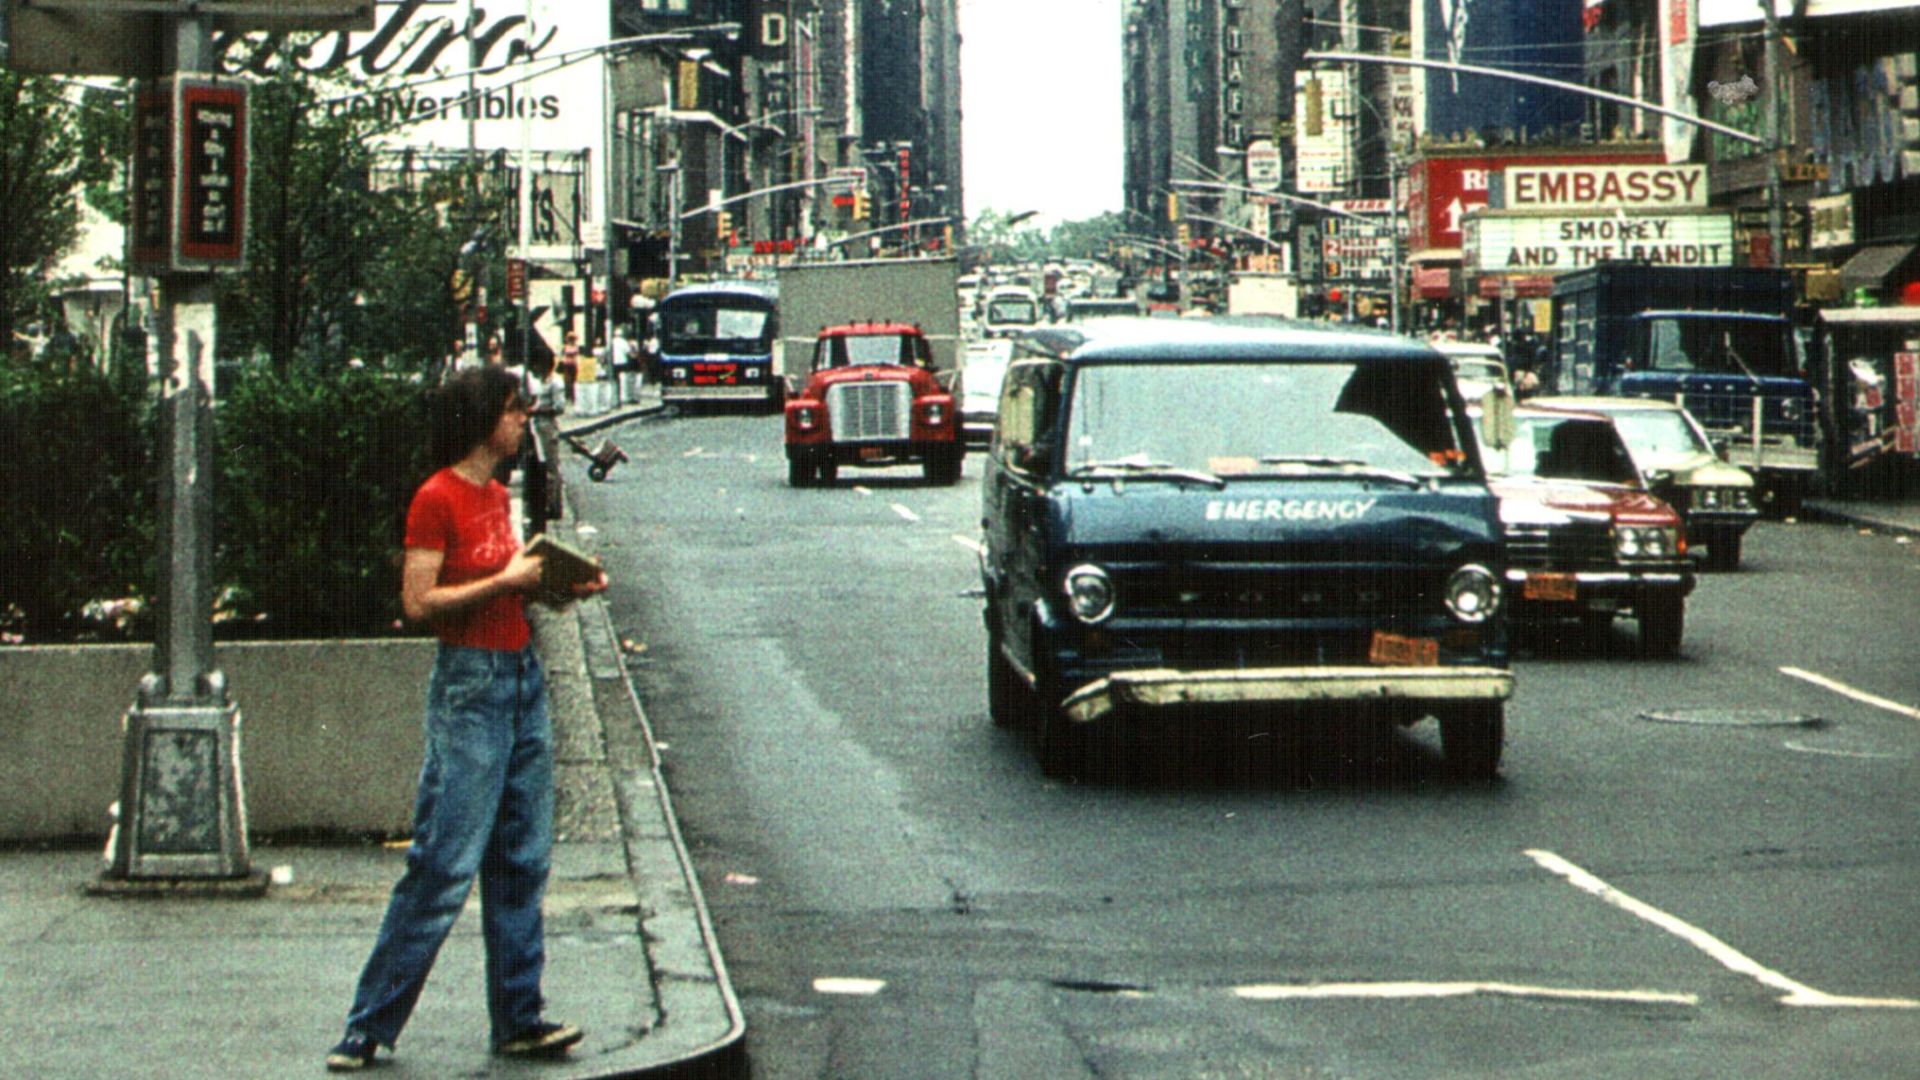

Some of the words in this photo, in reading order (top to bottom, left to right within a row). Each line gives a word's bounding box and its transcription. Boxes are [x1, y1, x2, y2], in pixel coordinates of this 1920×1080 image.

[1515, 171, 1701, 203] EMBASSY
[1560, 220, 1669, 240] SMOKEY
[1507, 246, 1558, 266] AND
[1570, 246, 1613, 264] THE
[1634, 245, 1722, 265] BANDIT
[1205, 499, 1378, 521] EMERGENCY
